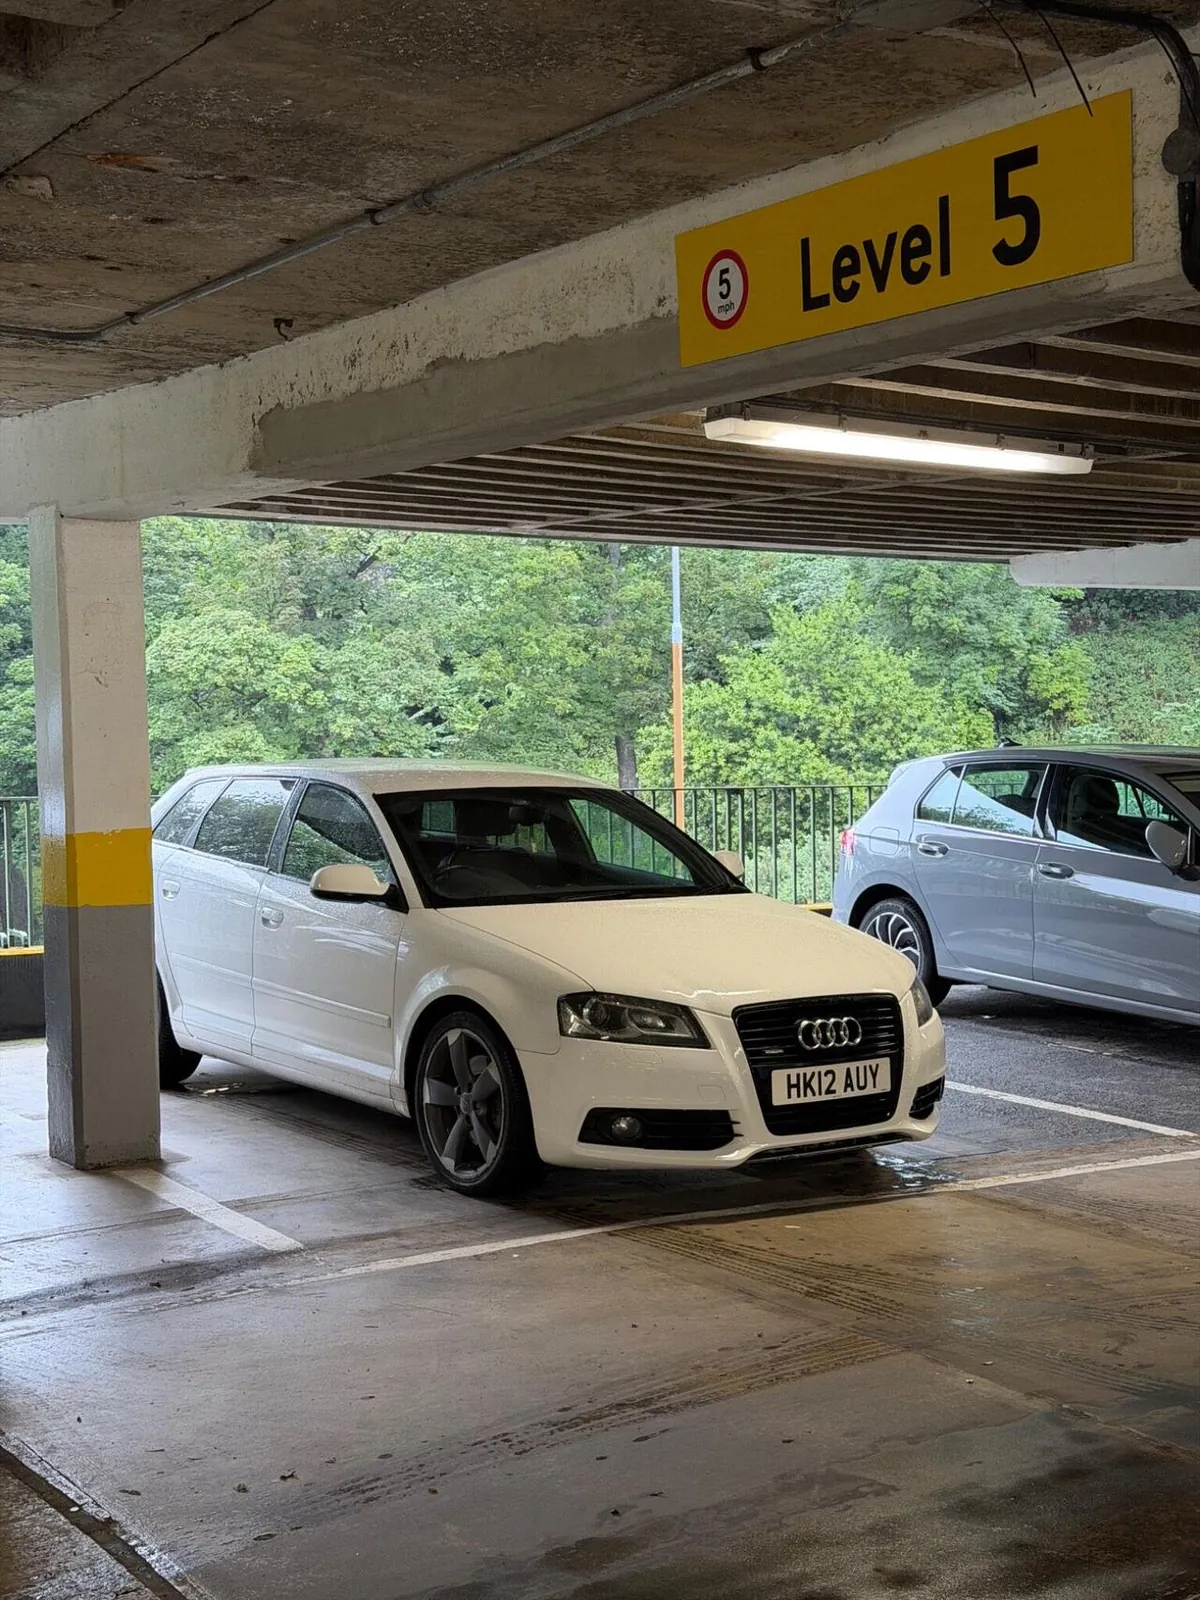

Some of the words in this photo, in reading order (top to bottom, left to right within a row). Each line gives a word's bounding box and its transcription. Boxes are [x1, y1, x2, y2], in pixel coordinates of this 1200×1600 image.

[800, 194, 951, 313] Level
[992, 145, 1041, 267] 5
[718, 267, 731, 300] 5
[717, 301, 735, 315] mph
[786, 1069, 837, 1099] HK12
[843, 1063, 880, 1093] AUY
